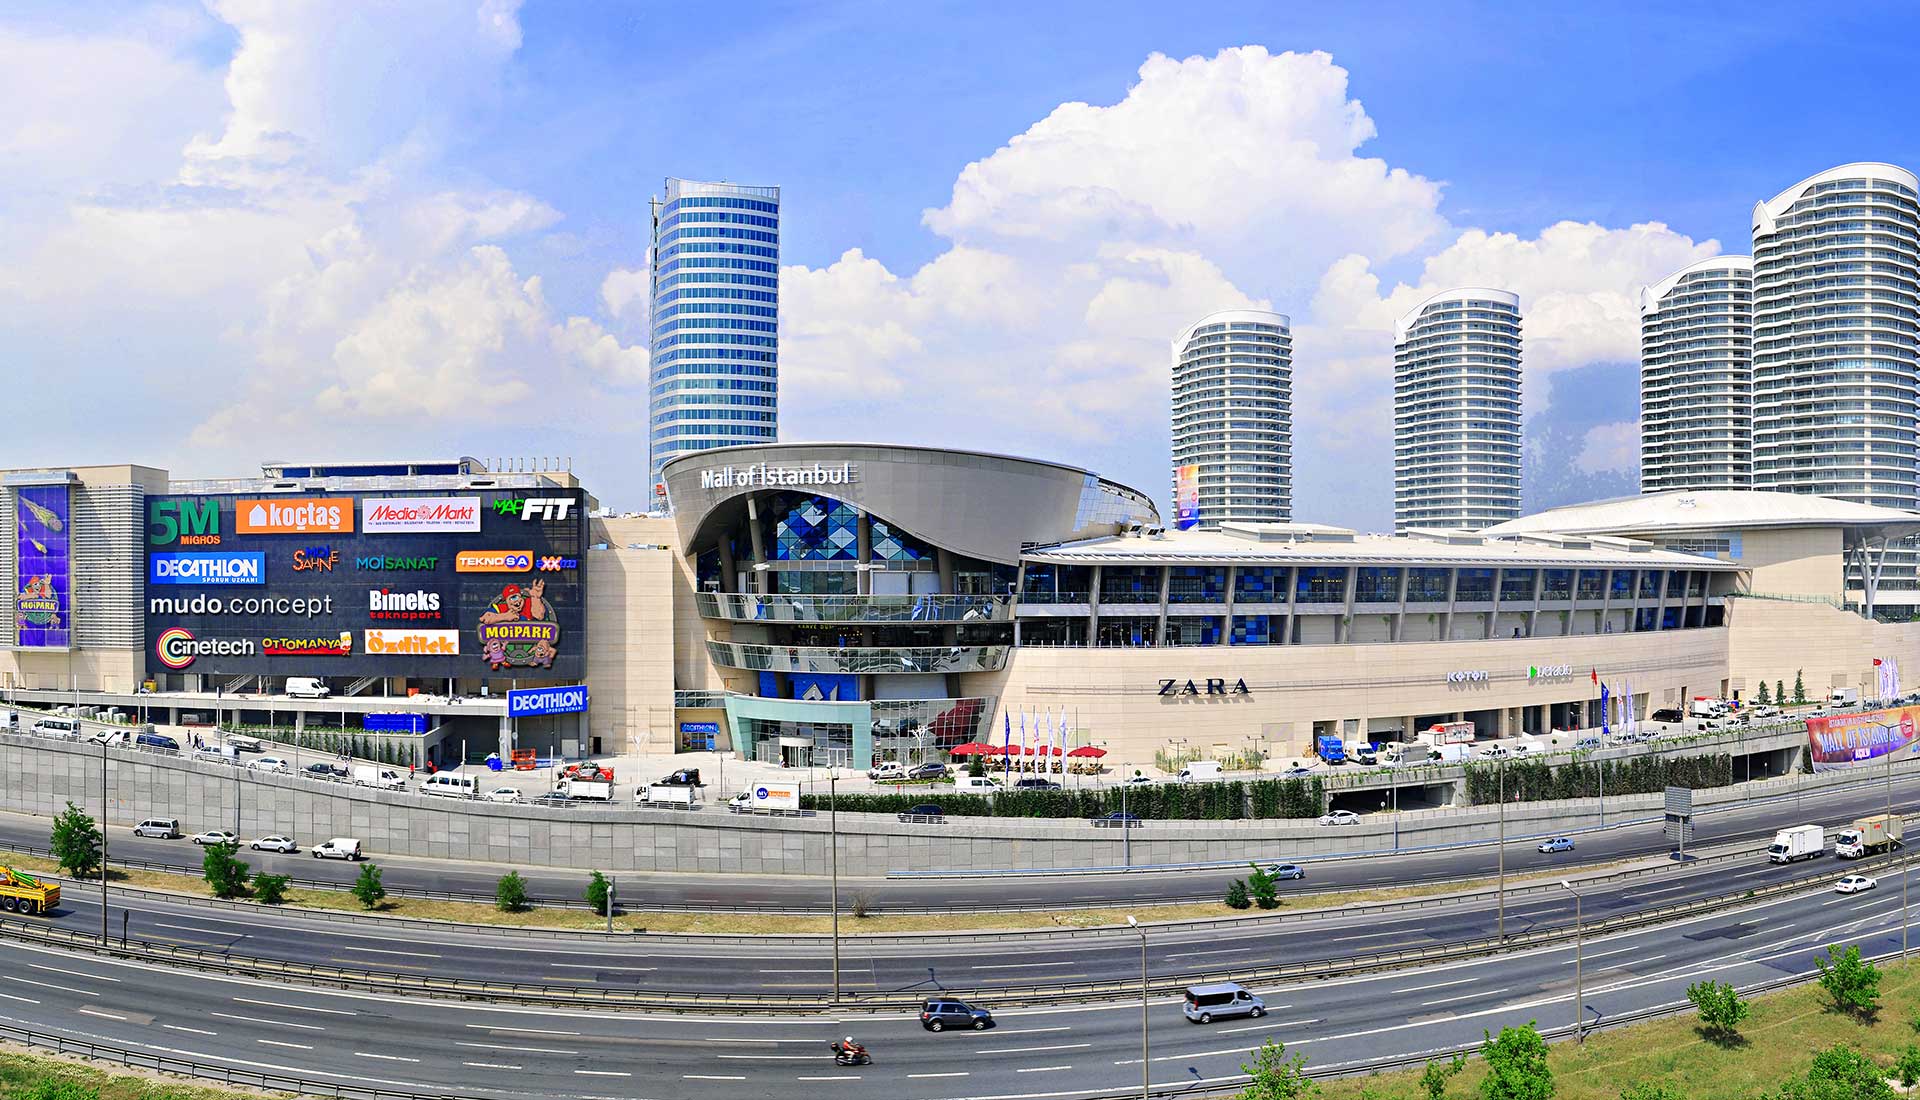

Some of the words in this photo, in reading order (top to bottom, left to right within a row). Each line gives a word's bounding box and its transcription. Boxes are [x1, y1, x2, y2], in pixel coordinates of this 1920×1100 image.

[701, 465, 732, 489] Mall
[737, 466, 756, 487] of
[151, 500, 219, 544] 5M
[269, 502, 340, 530] koçtaş
[369, 504, 418, 520] Media
[429, 504, 474, 520] Markt
[156, 558, 258, 577] DECATHLON
[459, 555, 528, 567] TEKNOSA
[150, 594, 333, 618] mudo.concept
[369, 588, 440, 612] Bimeks
[262, 637, 341, 650] OTTOMANYA
[367, 631, 455, 654] Özdilek
[1158, 677, 1252, 696] ZARA
[513, 691, 583, 711] DECATHLON
[1820, 732, 1845, 753] MALL
[1846, 730, 1857, 748] OF
